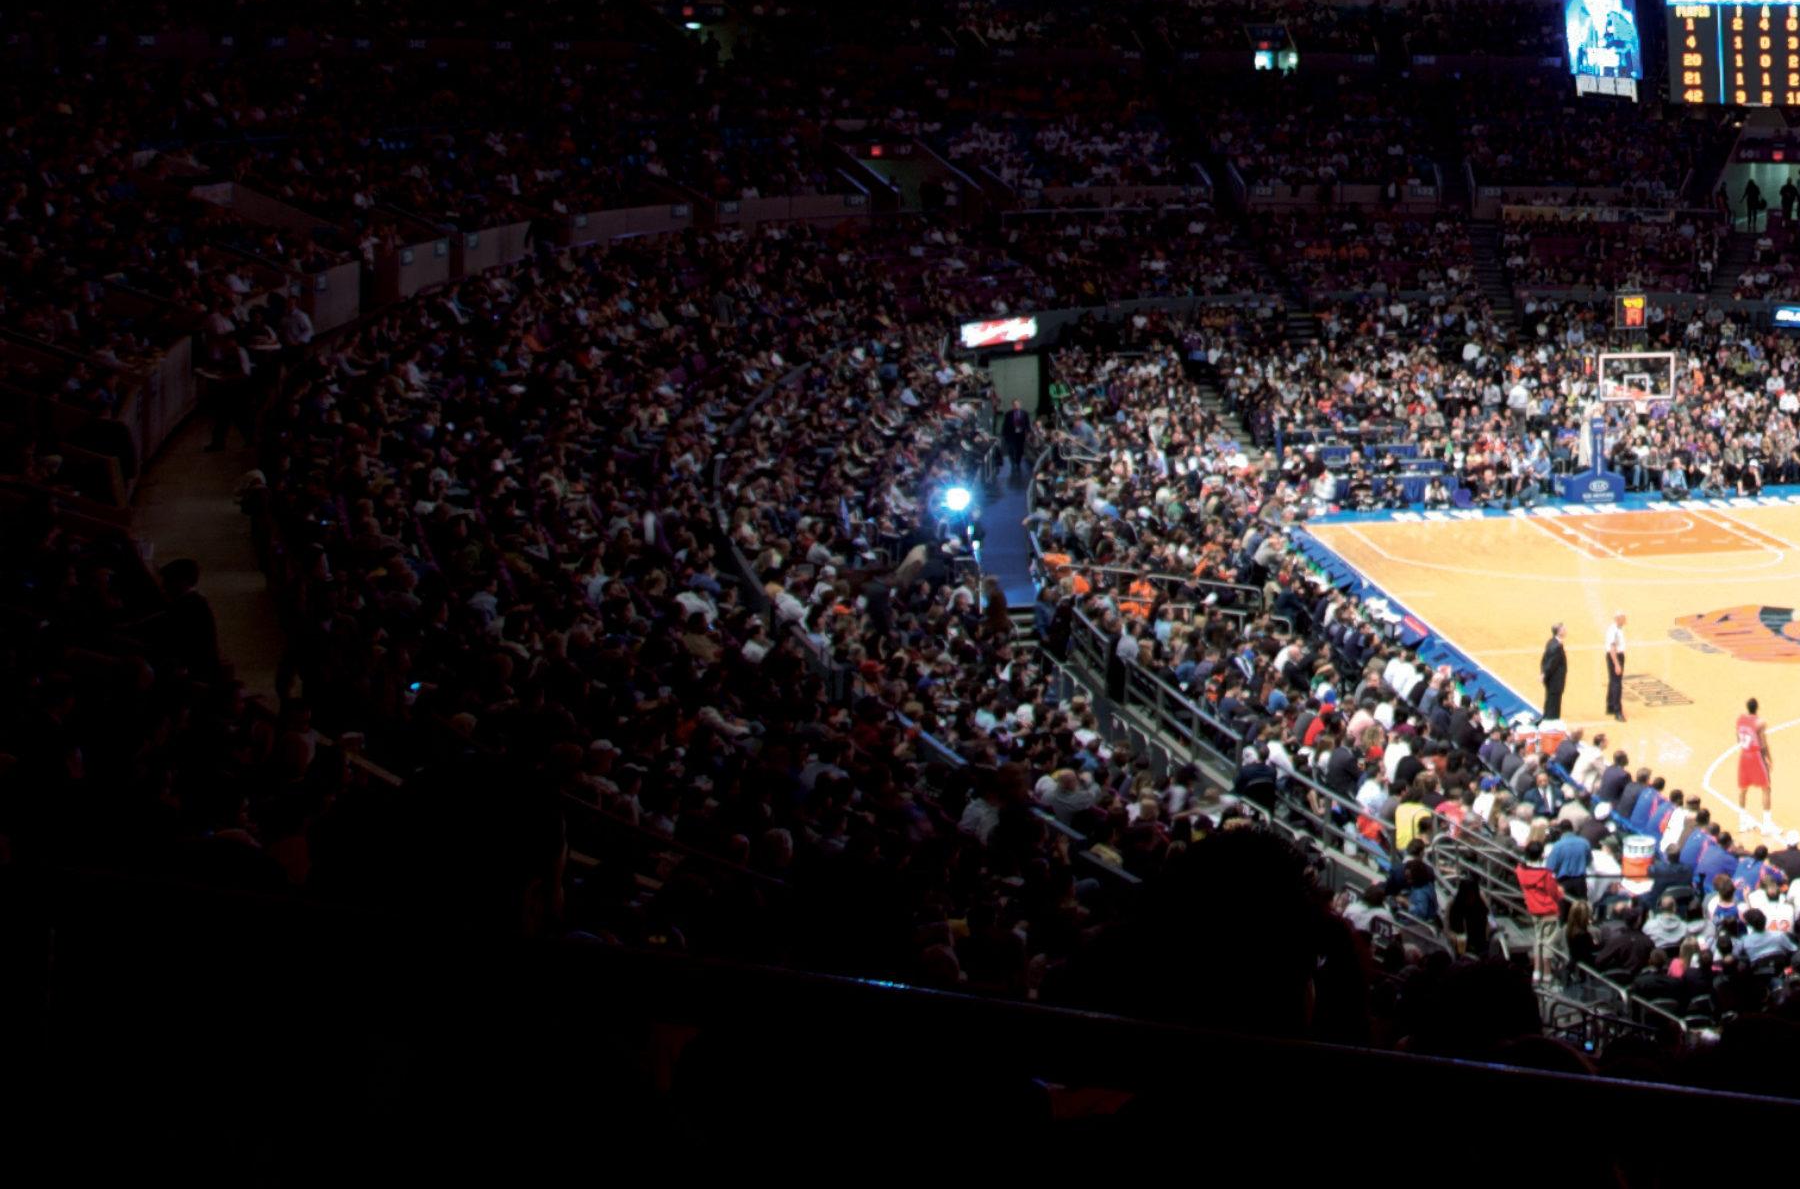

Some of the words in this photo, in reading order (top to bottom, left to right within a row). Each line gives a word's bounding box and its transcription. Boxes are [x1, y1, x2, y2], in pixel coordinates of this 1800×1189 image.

[1686, 18, 1695, 31] 1
[1732, 18, 1743, 31] 2
[1759, 18, 1770, 32] 4
[1686, 36, 1696, 49] 4
[1734, 36, 1743, 50] 1
[1760, 36, 1771, 50] 0
[1787, 36, 1798, 50] 3
[1683, 53, 1702, 67] 20
[1735, 53, 1743, 67] 1
[1788, 54, 1799, 68] 2
[1684, 71, 1701, 85] 21
[1736, 72, 1744, 86] 1
[1762, 72, 1771, 86] 1
[1788, 72, 1799, 87] 2
[1683, 89, 1703, 103] 42
[1762, 90, 1773, 104] 2
